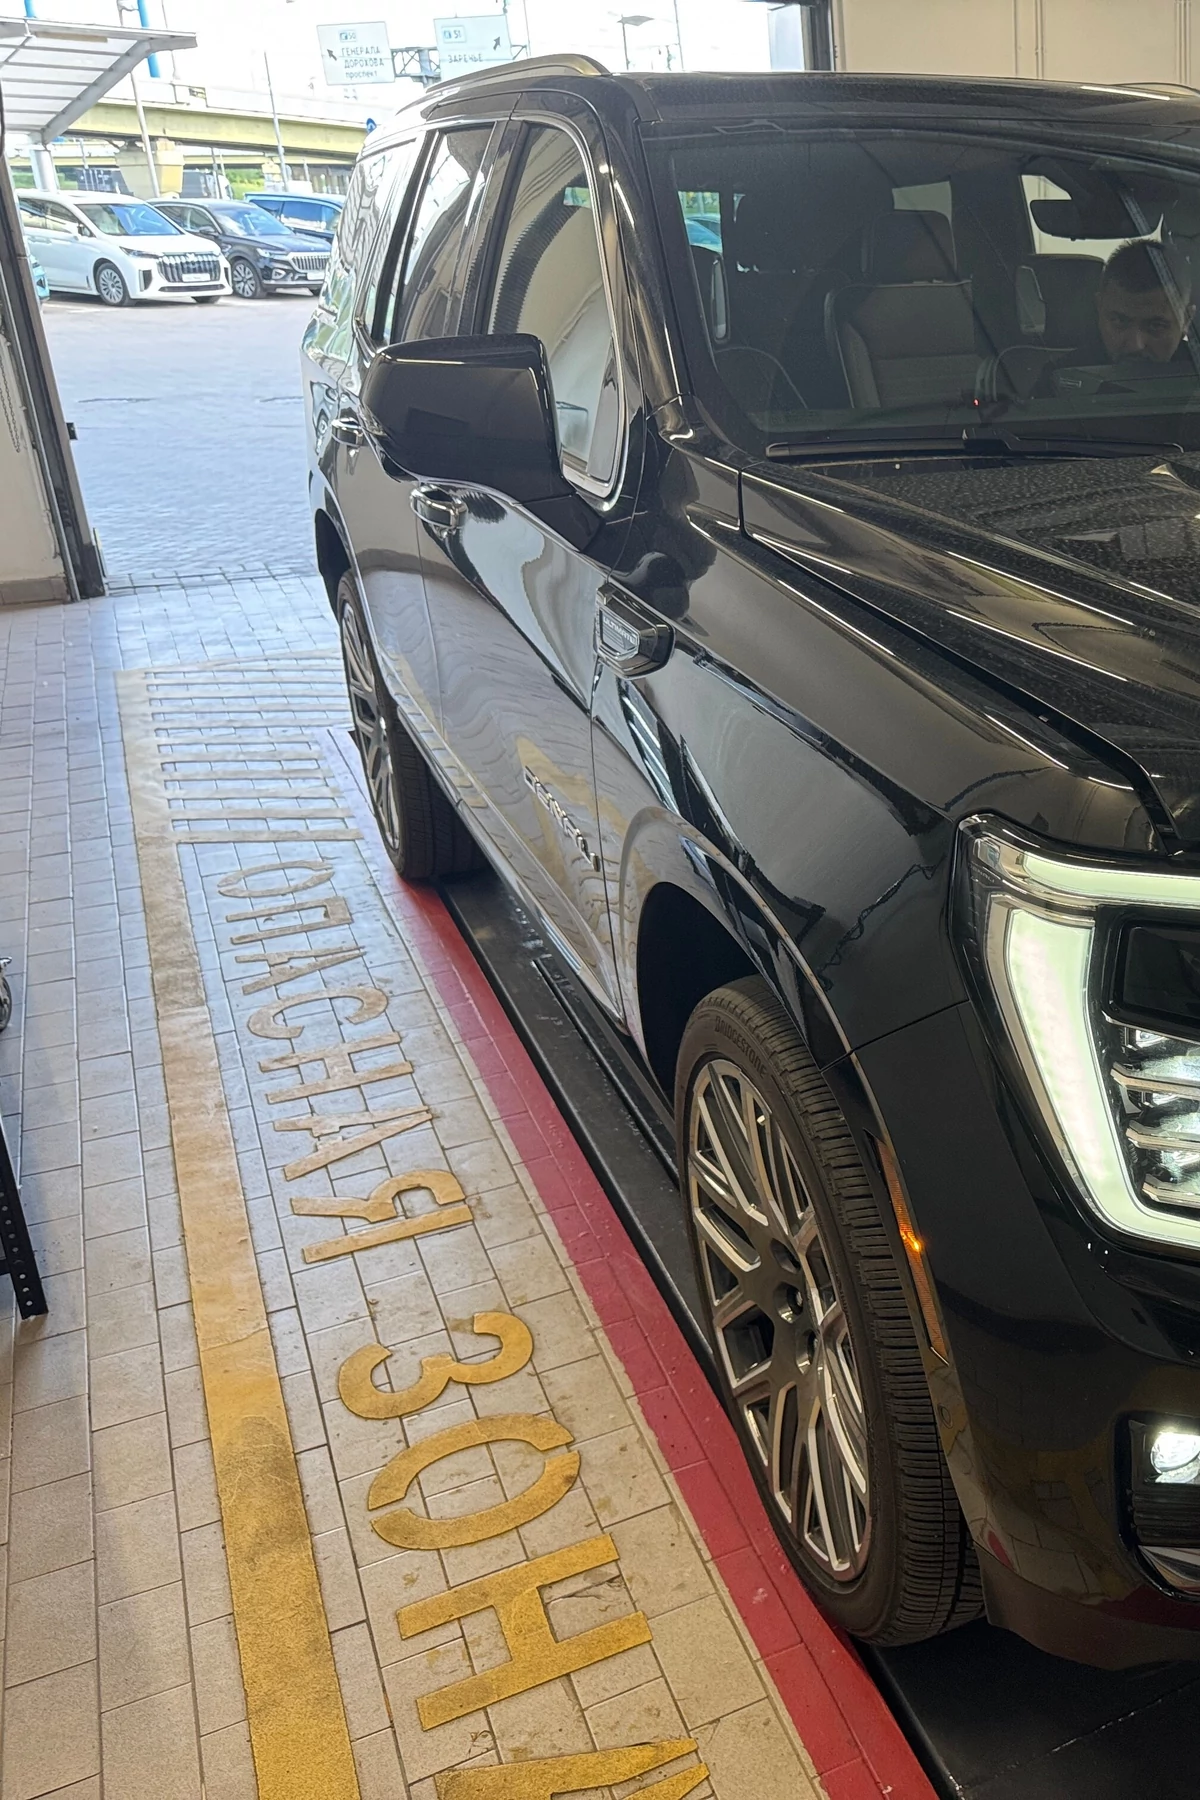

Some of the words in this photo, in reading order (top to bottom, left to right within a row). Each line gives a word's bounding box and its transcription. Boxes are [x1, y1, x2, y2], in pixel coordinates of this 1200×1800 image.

[341, 46, 381, 56] ГЕНЕРАЛА
[344, 57, 385, 69] ДОРОХОВА
[448, 53, 483, 63] ЗАРЕЧЬЕ
[345, 70, 378, 80] проспект
[714, 1015, 768, 1078] BRIDGESTONE
[216, 858, 475, 1264] ОПАСНАЯ
